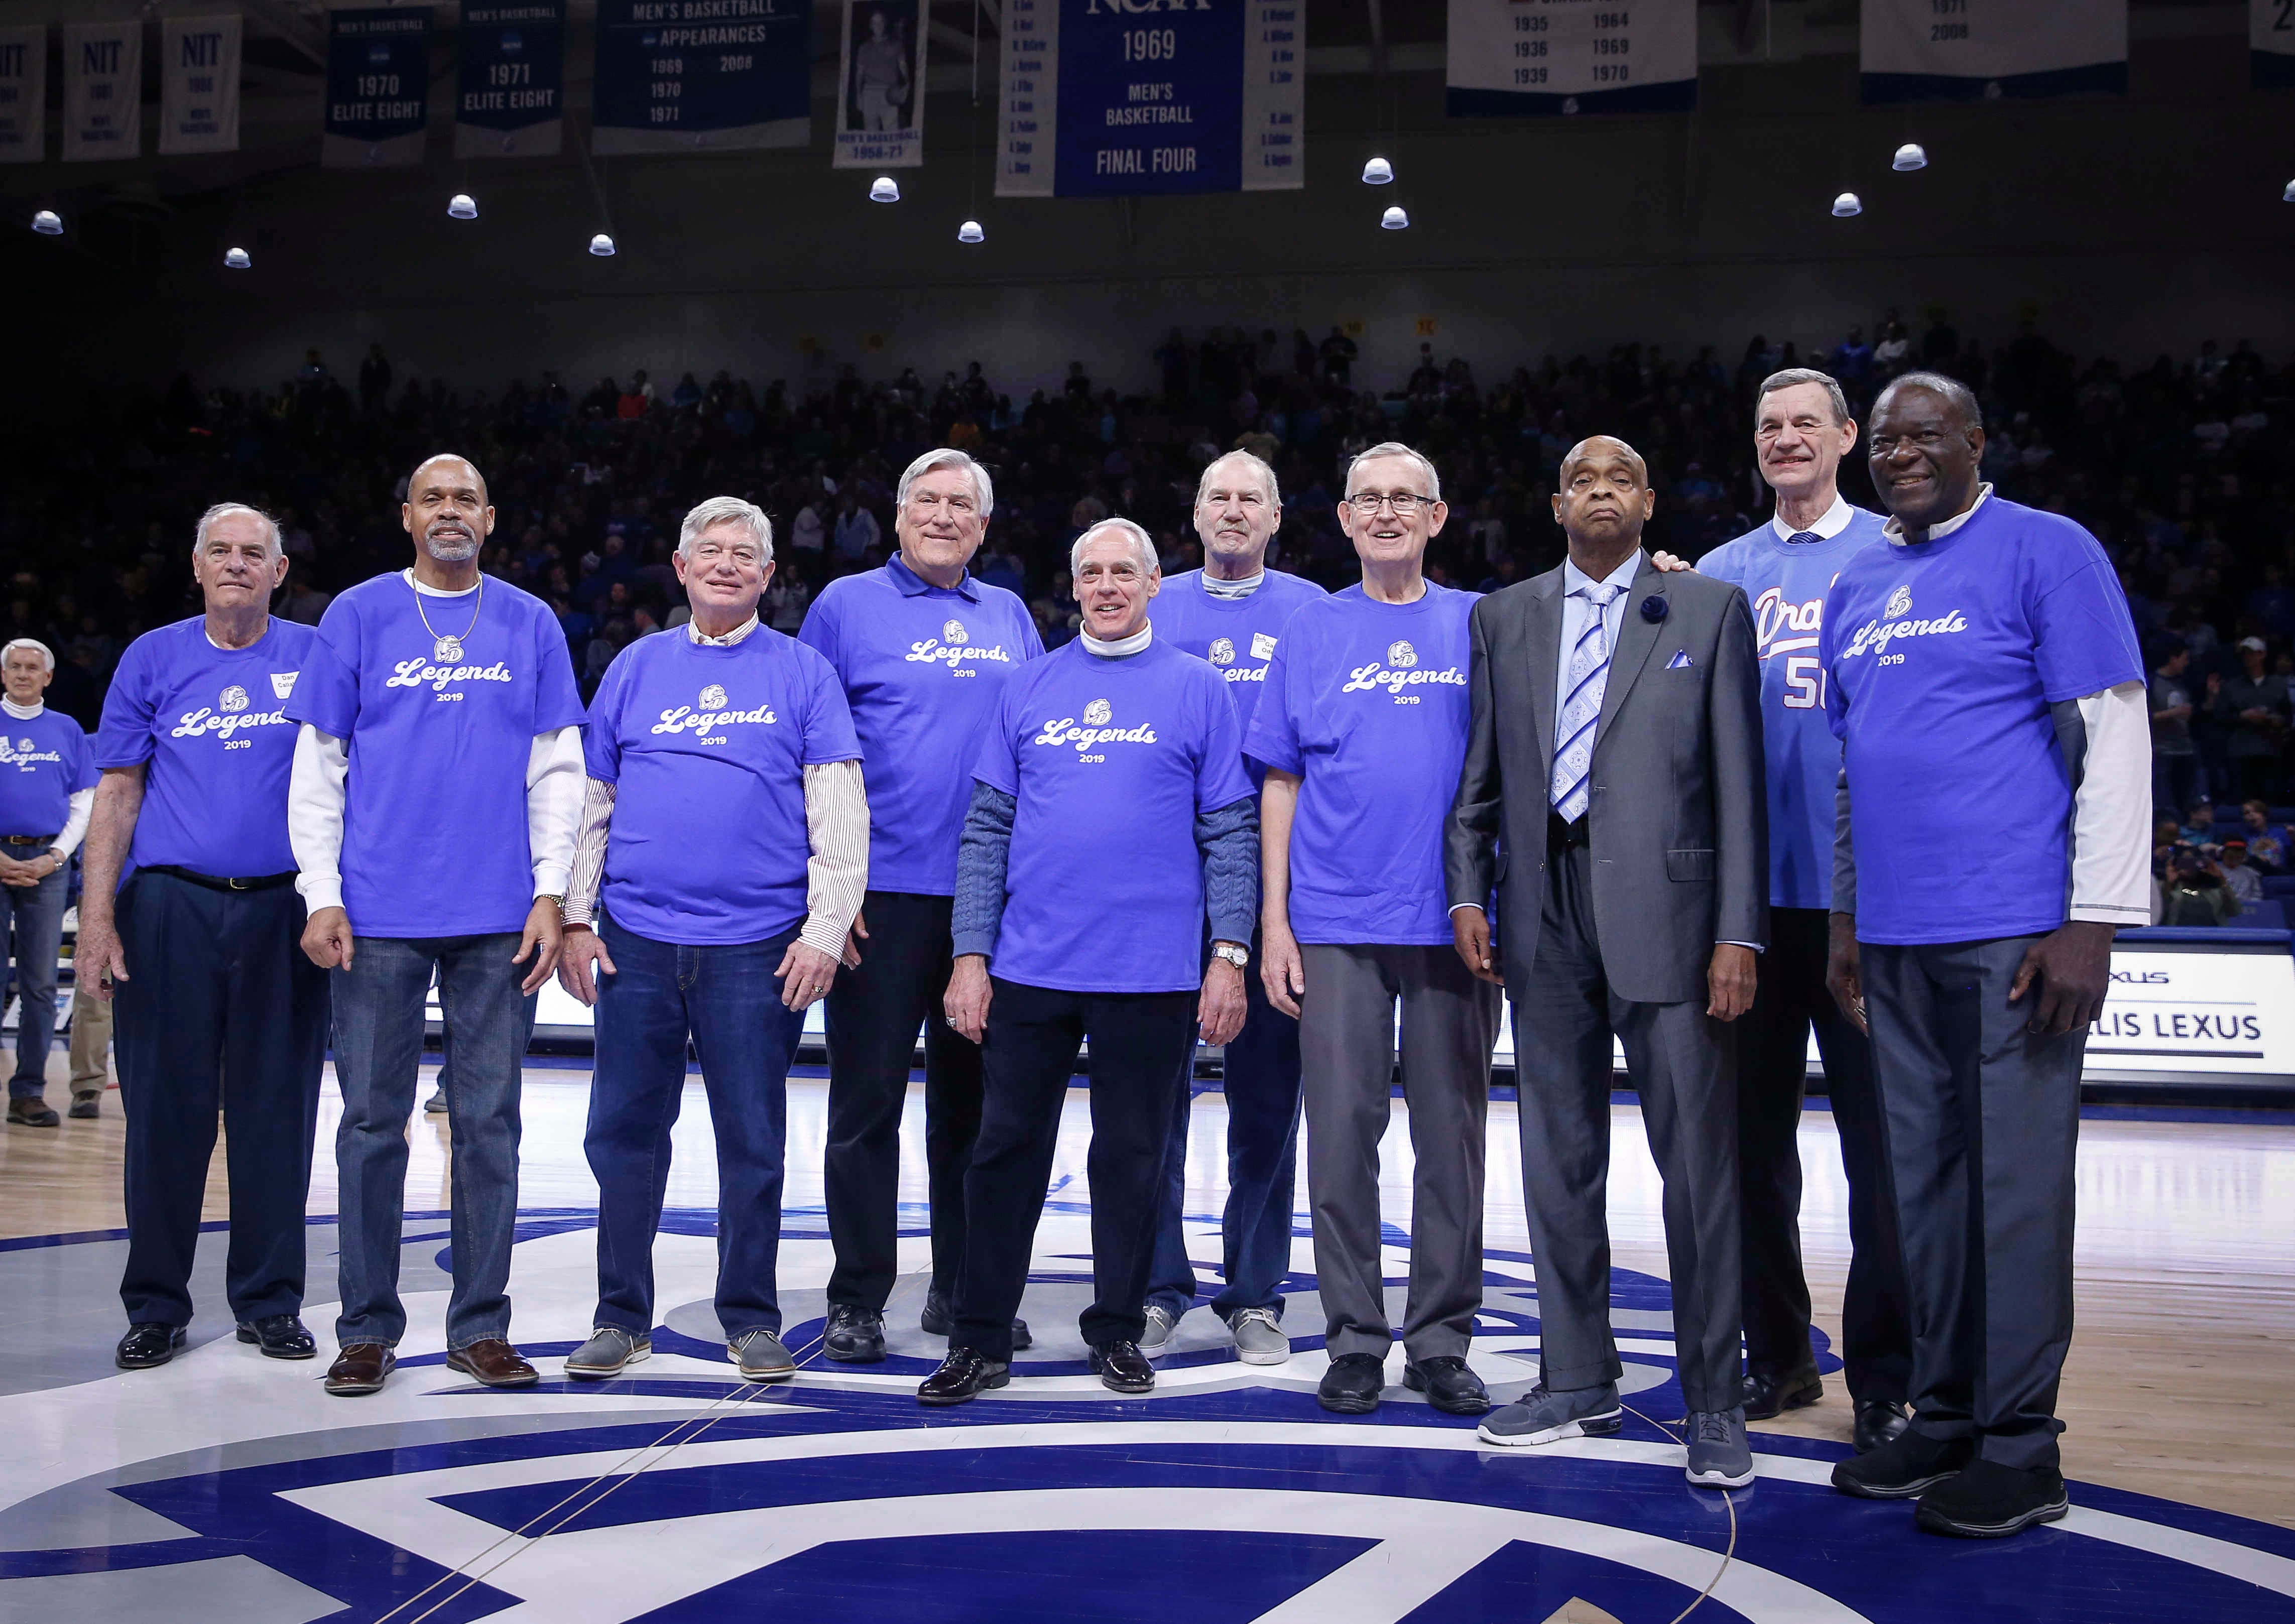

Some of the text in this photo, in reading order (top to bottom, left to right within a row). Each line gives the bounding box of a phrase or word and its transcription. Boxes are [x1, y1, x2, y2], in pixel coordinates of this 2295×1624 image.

[633, 0, 775, 20] MEN'S BASKETBALL
[1514, 16, 1548, 32] 1935
[1593, 11, 1629, 29] 1964
[660, 24, 766, 47] APPEARANCES
[1930, 24, 1969, 41] 2008
[181, 33, 222, 68] NIT
[1123, 29, 1176, 61] 1969
[1514, 40, 1548, 58] 1936
[1593, 38, 1630, 55] 1969
[82, 40, 123, 75] NIT
[652, 58, 683, 74] 1969
[720, 54, 752, 72] 2008
[489, 63, 531, 85] 1971
[1514, 67, 1548, 84] 1939
[1592, 64, 1630, 81] 1970
[357, 74, 400, 97] 1970
[652, 81, 681, 98] 1970
[1129, 83, 1173, 101] MEN'S
[464, 89, 554, 111] ELITE EIGHT
[332, 102, 422, 121] ELITE EIGHT
[650, 106, 678, 122] 1971
[1106, 106, 1193, 127] BASKETBALL
[1097, 147, 1196, 175] FINAL FOUR
[1843, 609, 1968, 659] Legends
[905, 638, 1010, 668] Legends
[1878, 654, 1905, 667] 2019
[386, 657, 512, 691] Legends
[952, 669, 976, 678] 2019
[1342, 662, 1467, 694] Legends
[436, 692, 463, 702] 2019
[1393, 696, 1420, 705] 2019
[171, 706, 293, 739] Legend
[651, 704, 777, 736] Legends
[700, 736, 727, 745] 2019
[1035, 717, 1158, 752] Legends
[224, 739, 252, 750] 2019
[1079, 754, 1105, 763] 2019
[2153, 1013, 2261, 1040] LEXUS
